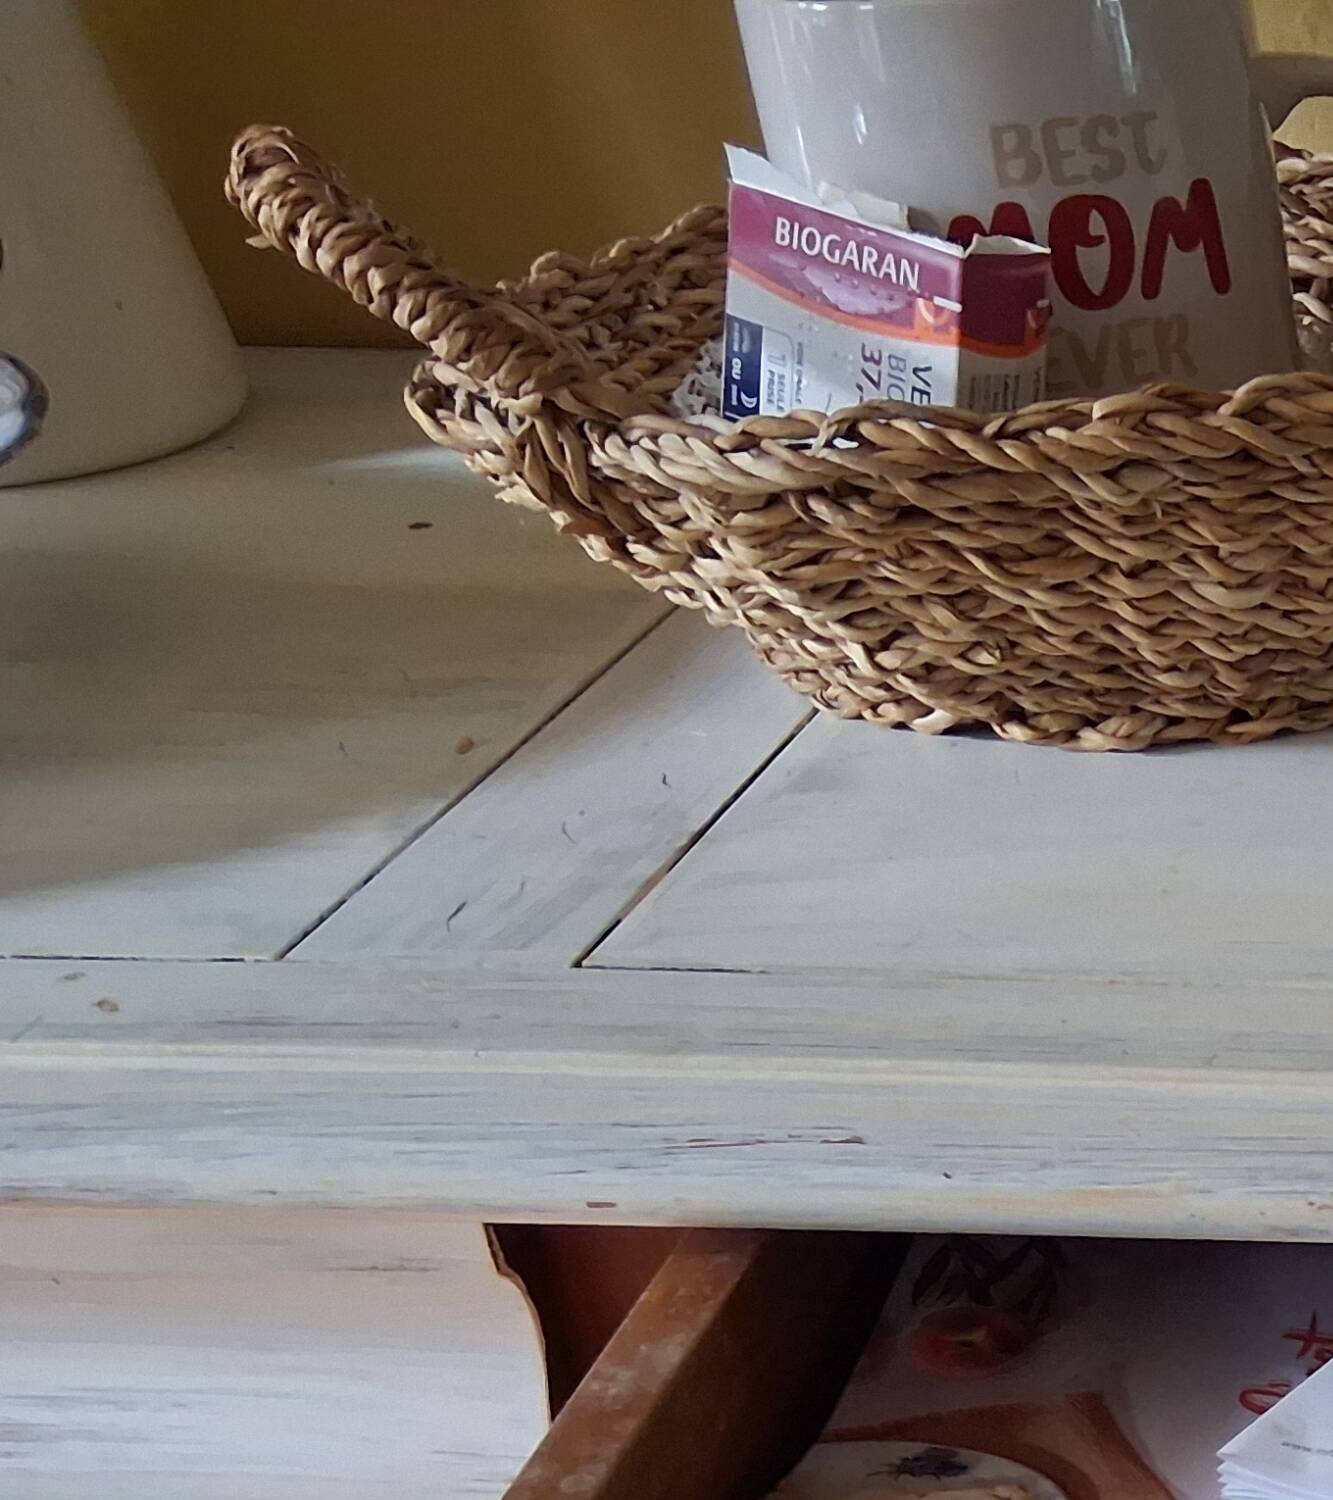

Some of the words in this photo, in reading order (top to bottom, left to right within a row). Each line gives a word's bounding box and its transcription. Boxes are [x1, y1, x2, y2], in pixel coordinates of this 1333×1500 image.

[990, 112, 1168, 189] BEST
[775, 216, 921, 293] BIOGARAN
[731, 357, 741, 380] OU
